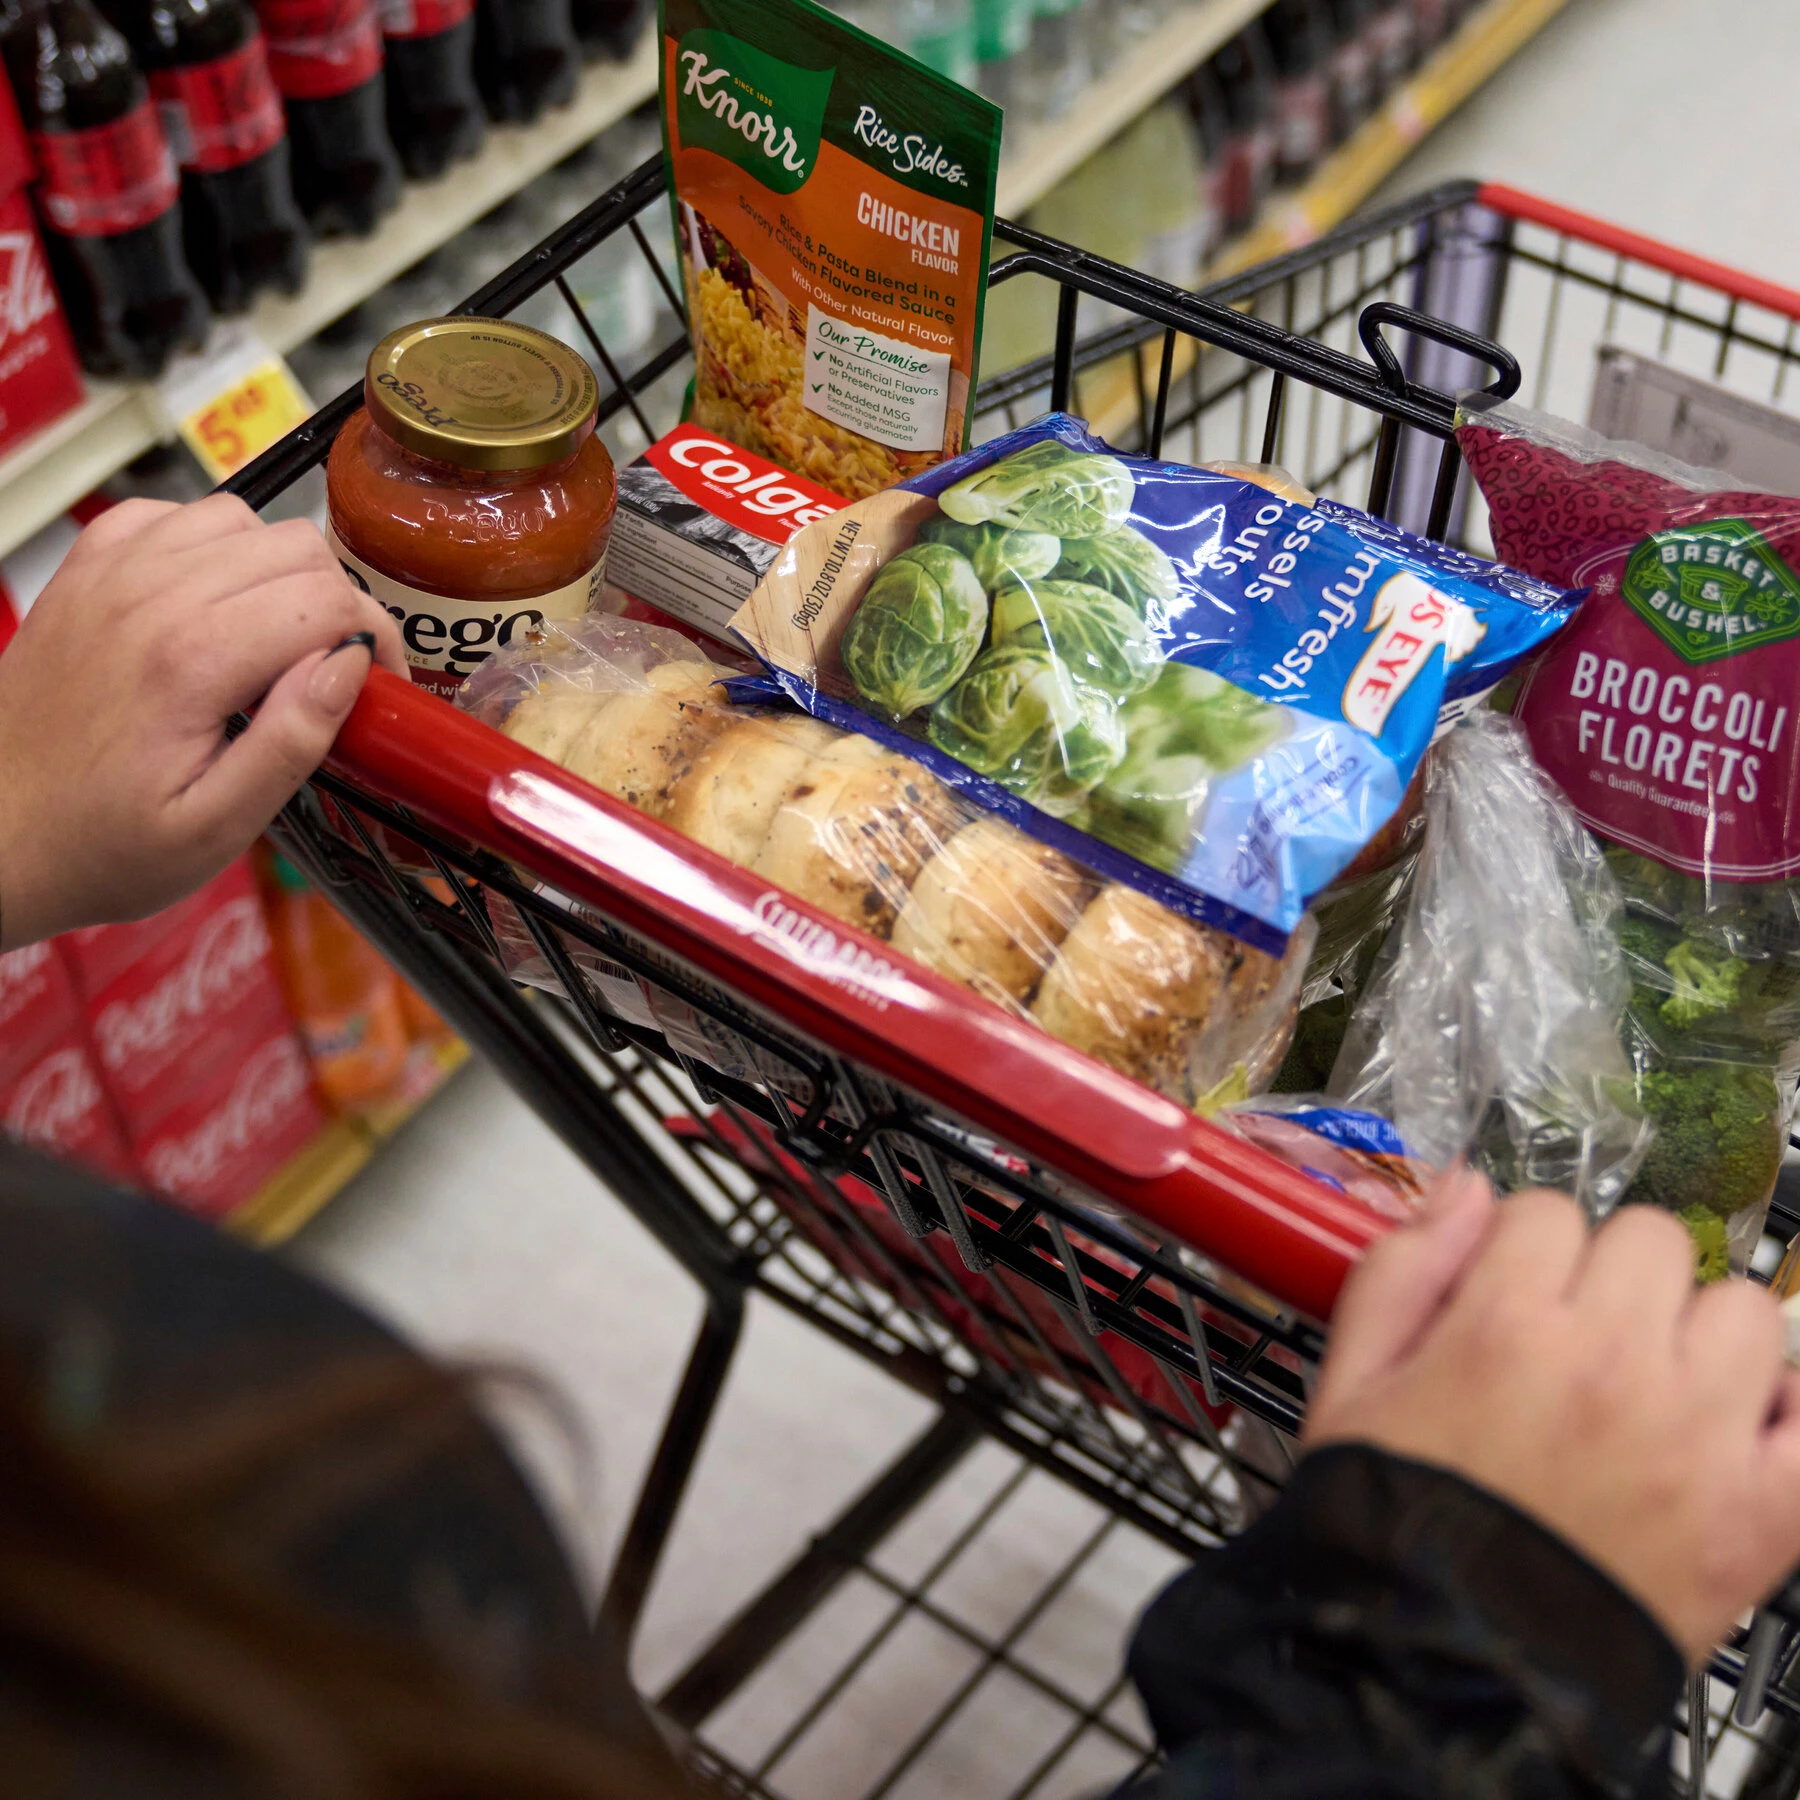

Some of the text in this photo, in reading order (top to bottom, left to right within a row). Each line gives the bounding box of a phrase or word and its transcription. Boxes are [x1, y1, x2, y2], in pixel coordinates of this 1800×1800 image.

[681, 50, 805, 171] Knorr
[733, 77, 754, 97] SINCE
[853, 105, 966, 184] Rice Sides
[857, 192, 960, 257] CHICKEN
[739, 195, 955, 326] Savory Chicken Flavored Sauce
[780, 213, 956, 308] Rice & Pasta Blend in a
[911, 249, 959, 276] FLAVOR
[791, 266, 955, 347] With Other Natural Flavor
[492, 337, 522, 348] BUTTON
[522, 344, 548, 365] SAFETY
[818, 320, 931, 374] Our Promise
[377, 373, 458, 427] Prego
[828, 367, 915, 406] or Preservatives
[829, 353, 940, 397] No Artificial Flavors
[826, 404, 913, 443] occurring glutamates
[827, 393, 919, 435] Except those naturally
[828, 382, 911, 423] No Added MSG
[701, 481, 736, 499] Anticavity
[789, 518, 863, 633] NET WT 10.8 OZ (306g)
[1244, 502, 1327, 603] ssels
[1661, 542, 1776, 588] BASKET
[1648, 593, 1757, 633] BUSHEL
[1701, 581, 1720, 601] &
[1257, 547, 1381, 690] mfresh
[1358, 631, 1423, 702] EYE
[1570, 651, 1787, 754] BROCCOLI
[1578, 710, 1762, 803] FLORETS
[1608, 773, 1647, 799] Quality
